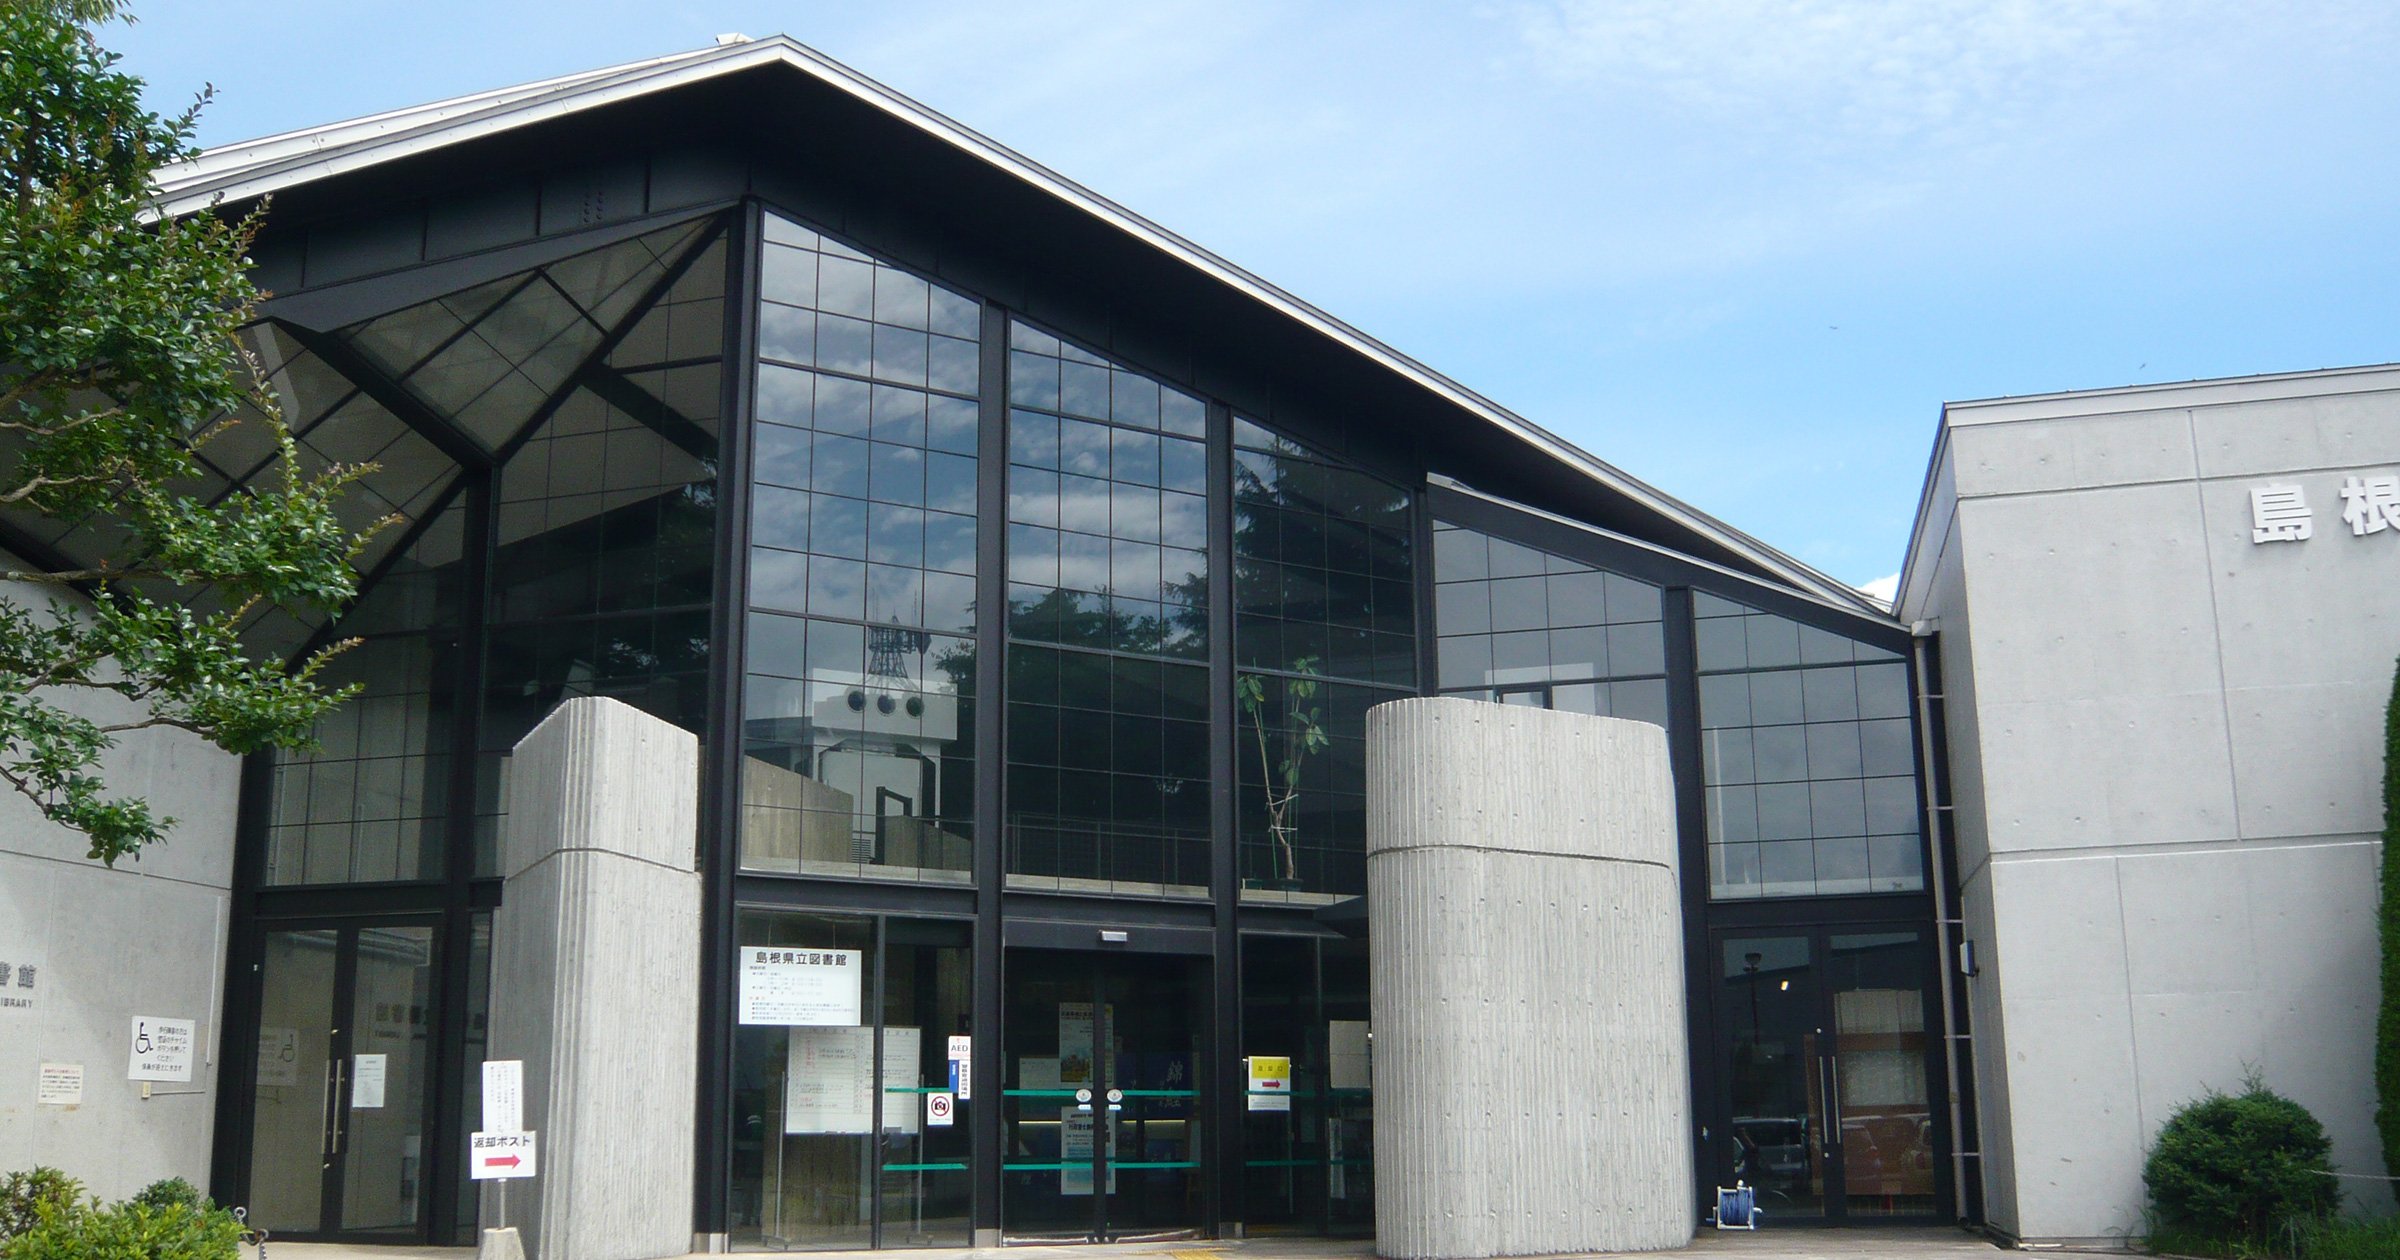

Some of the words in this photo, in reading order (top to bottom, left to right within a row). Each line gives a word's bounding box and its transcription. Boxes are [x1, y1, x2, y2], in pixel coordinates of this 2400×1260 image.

[755, 951, 848, 967] 島根県立図書館
[950, 1044, 969, 1053] AED
[473, 1135, 532, 1149] 返却ポスト
